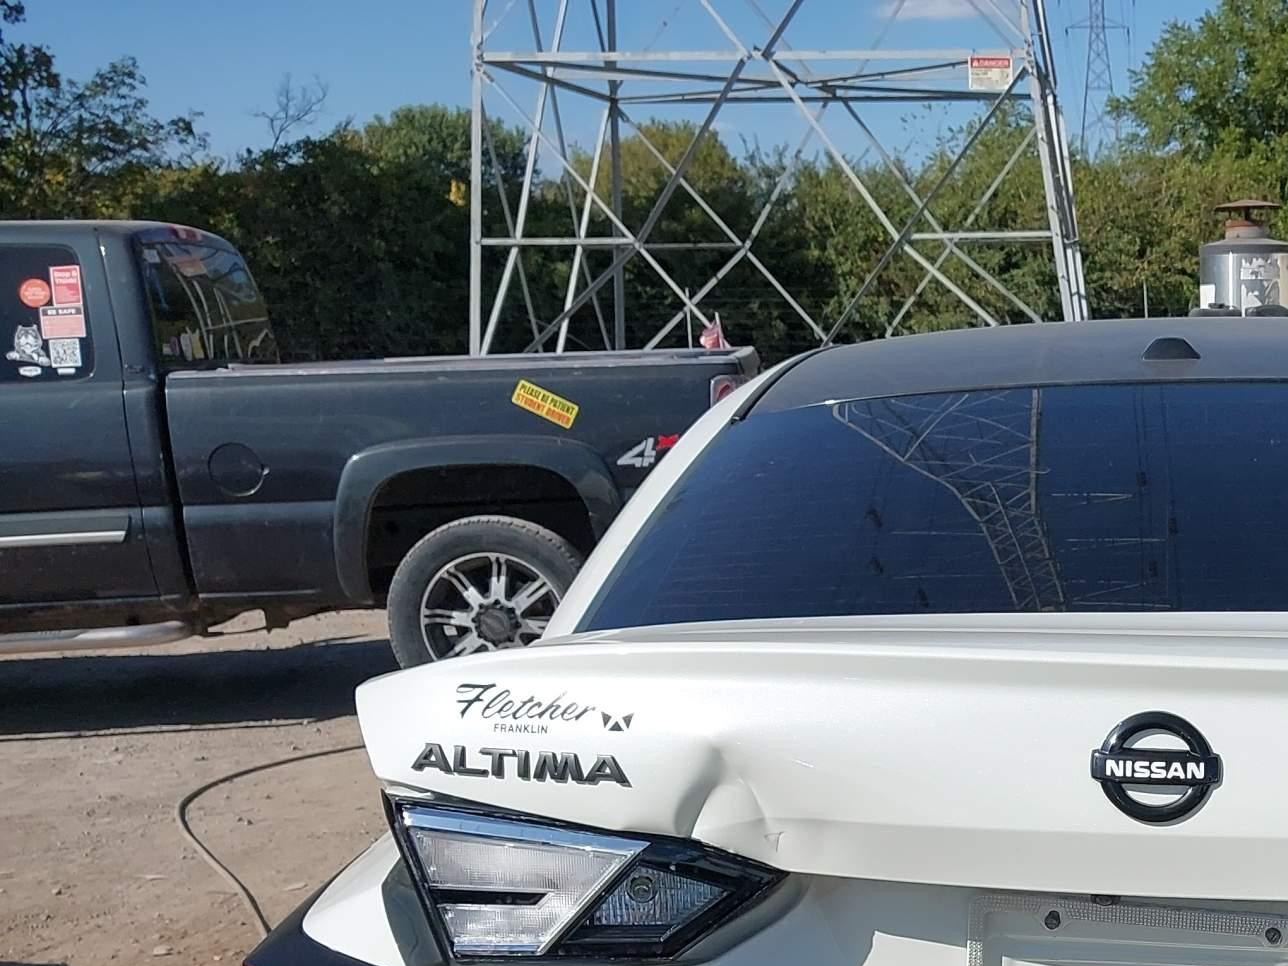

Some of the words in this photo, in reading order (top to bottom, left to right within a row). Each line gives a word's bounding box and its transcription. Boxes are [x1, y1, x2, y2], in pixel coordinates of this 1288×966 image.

[456, 683, 596, 722] Fletcher
[493, 723, 548, 735] FRANKLIN
[411, 742, 633, 788] ALTIMA
[1105, 759, 1205, 780] NISSAN
